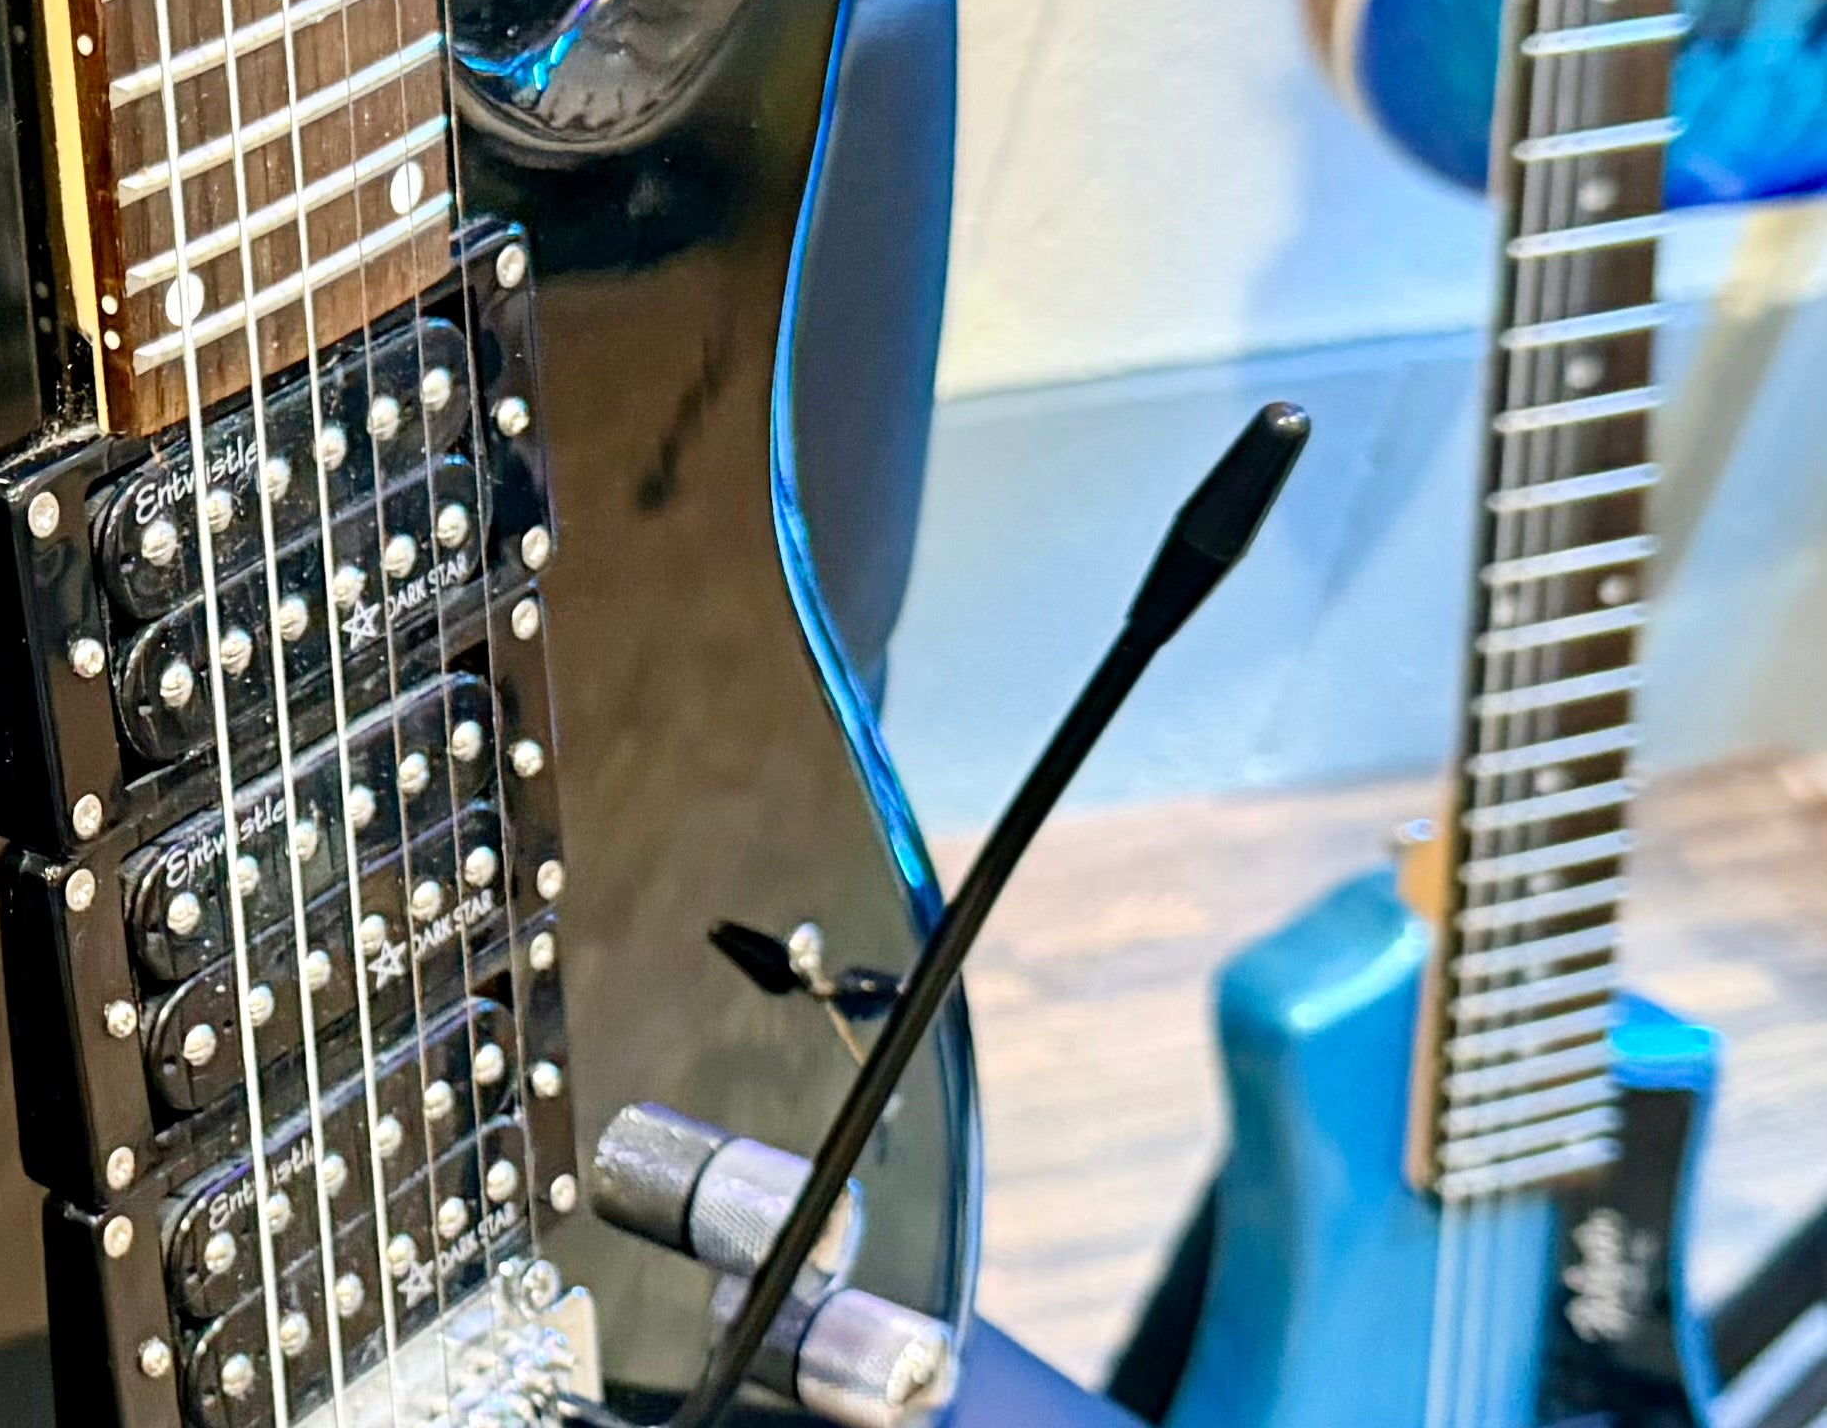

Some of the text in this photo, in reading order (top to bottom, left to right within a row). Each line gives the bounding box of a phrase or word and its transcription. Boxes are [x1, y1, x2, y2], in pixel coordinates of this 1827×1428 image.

[427, 549, 469, 594] STAR
[165, 795, 286, 888] Entwstle
[208, 1137, 316, 1233] Entistl
